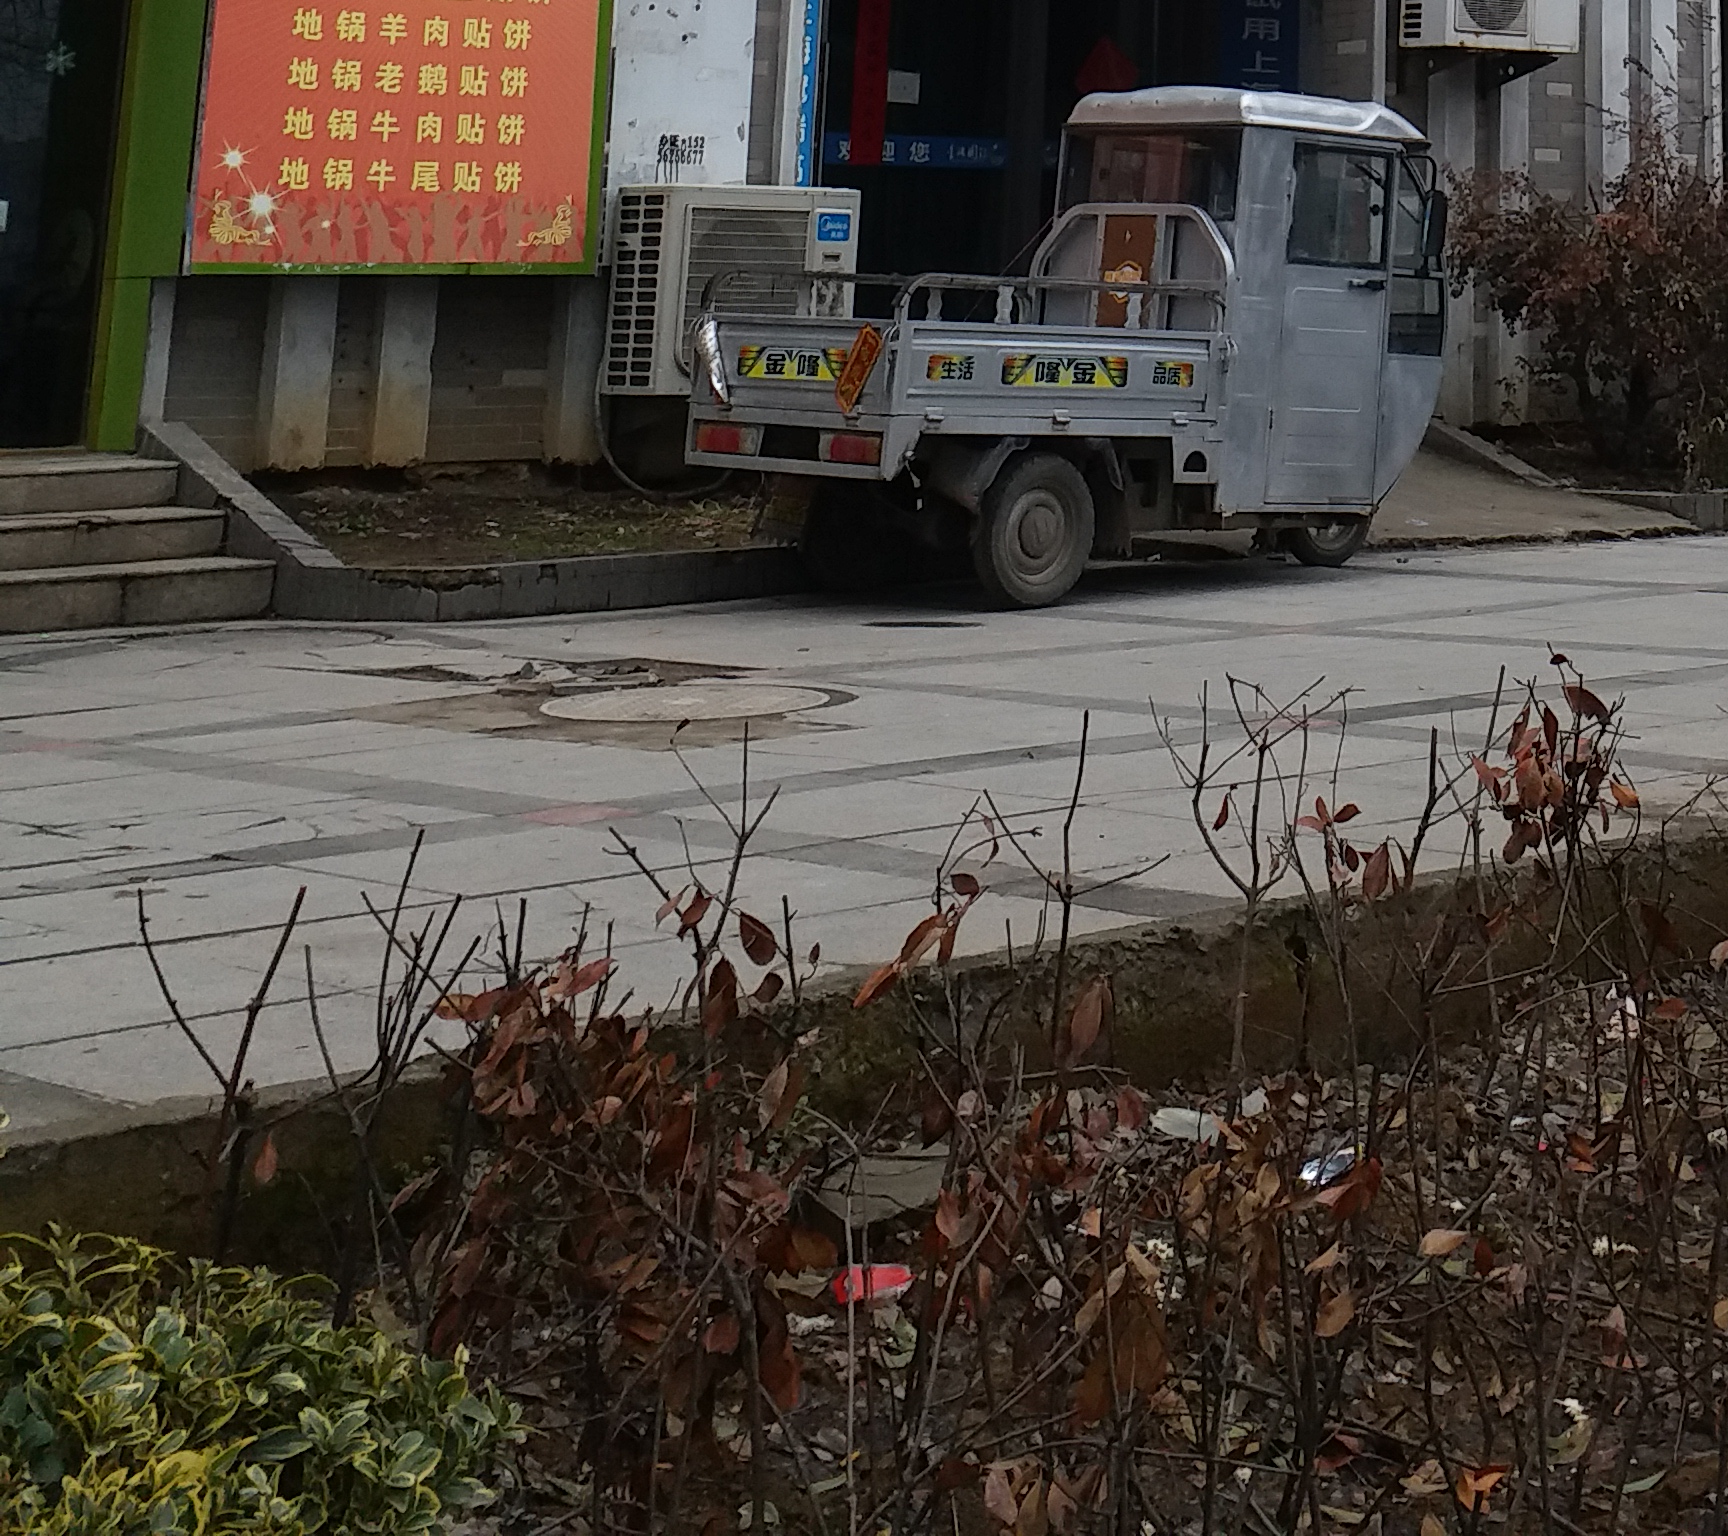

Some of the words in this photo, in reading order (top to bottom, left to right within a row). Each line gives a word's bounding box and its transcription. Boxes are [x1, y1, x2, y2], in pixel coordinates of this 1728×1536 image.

[292, 8, 532, 51] 地锅羊肉贴饼
[287, 57, 529, 100] 地锅老鹅贴饼
[283, 107, 525, 148] 地锅牛肉贴饼
[279, 157, 523, 196] 地锅牛尾贴饼
[940, 360, 974, 381] 生活
[1151, 365, 1180, 385] 品质
